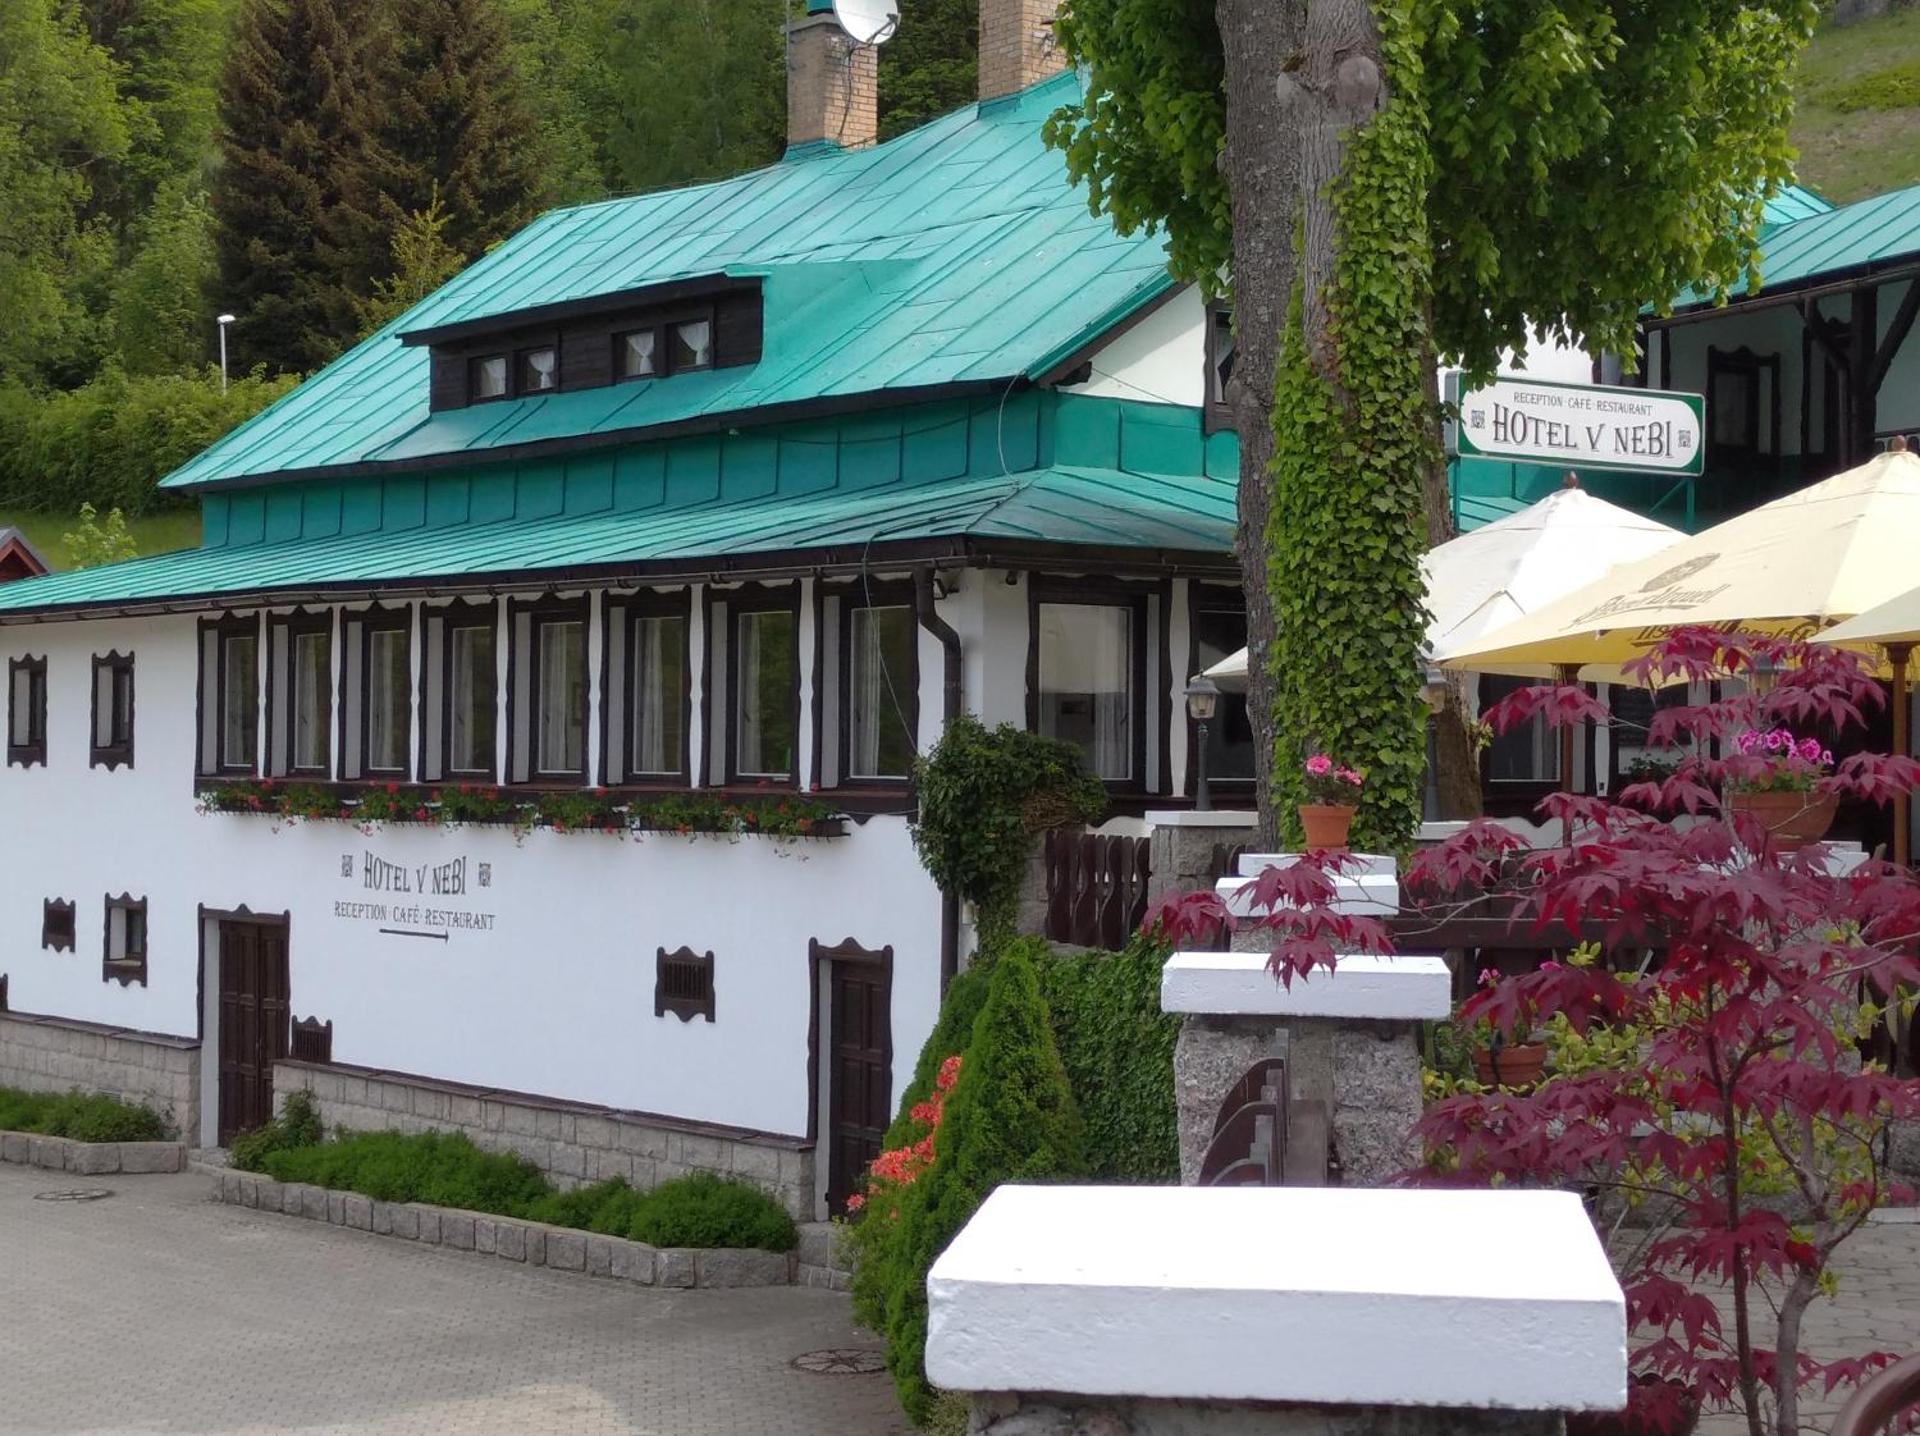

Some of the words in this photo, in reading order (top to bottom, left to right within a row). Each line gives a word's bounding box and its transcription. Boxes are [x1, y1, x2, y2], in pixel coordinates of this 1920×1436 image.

[1513, 392, 1563, 407] RECEPTION
[1596, 400, 1653, 416] RESTAURANT
[1493, 402, 1578, 449] HOTEL
[1586, 423, 1605, 450] V
[1614, 420, 1674, 458] NEBI
[364, 850, 411, 893] HOTEL
[416, 864, 427, 893] V
[432, 856, 467, 895] NEBI
[334, 901, 387, 920] RECEPTION
[393, 904, 420, 923] CAFÉ
[425, 908, 496, 930] RESTAURANT
